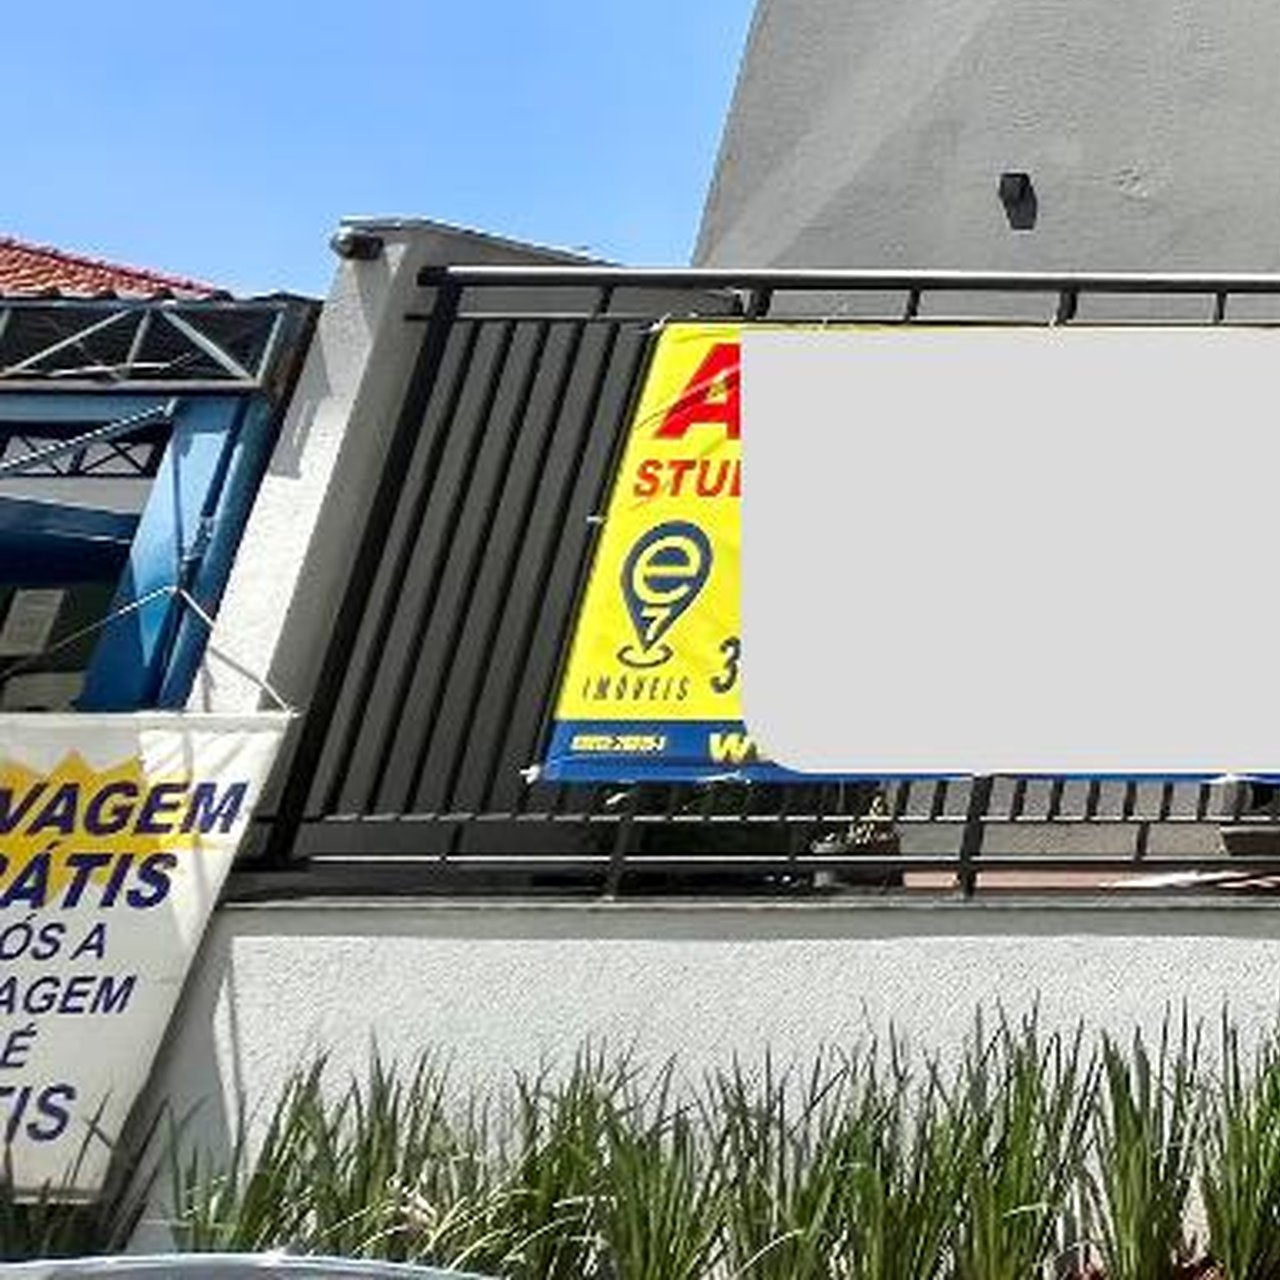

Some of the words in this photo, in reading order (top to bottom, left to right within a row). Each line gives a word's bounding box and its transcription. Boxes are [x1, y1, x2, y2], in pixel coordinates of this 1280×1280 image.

[0, 841, 177, 910] ÁTIS
[70, 923, 106, 960] A
[0, 1022, 37, 1068] É
